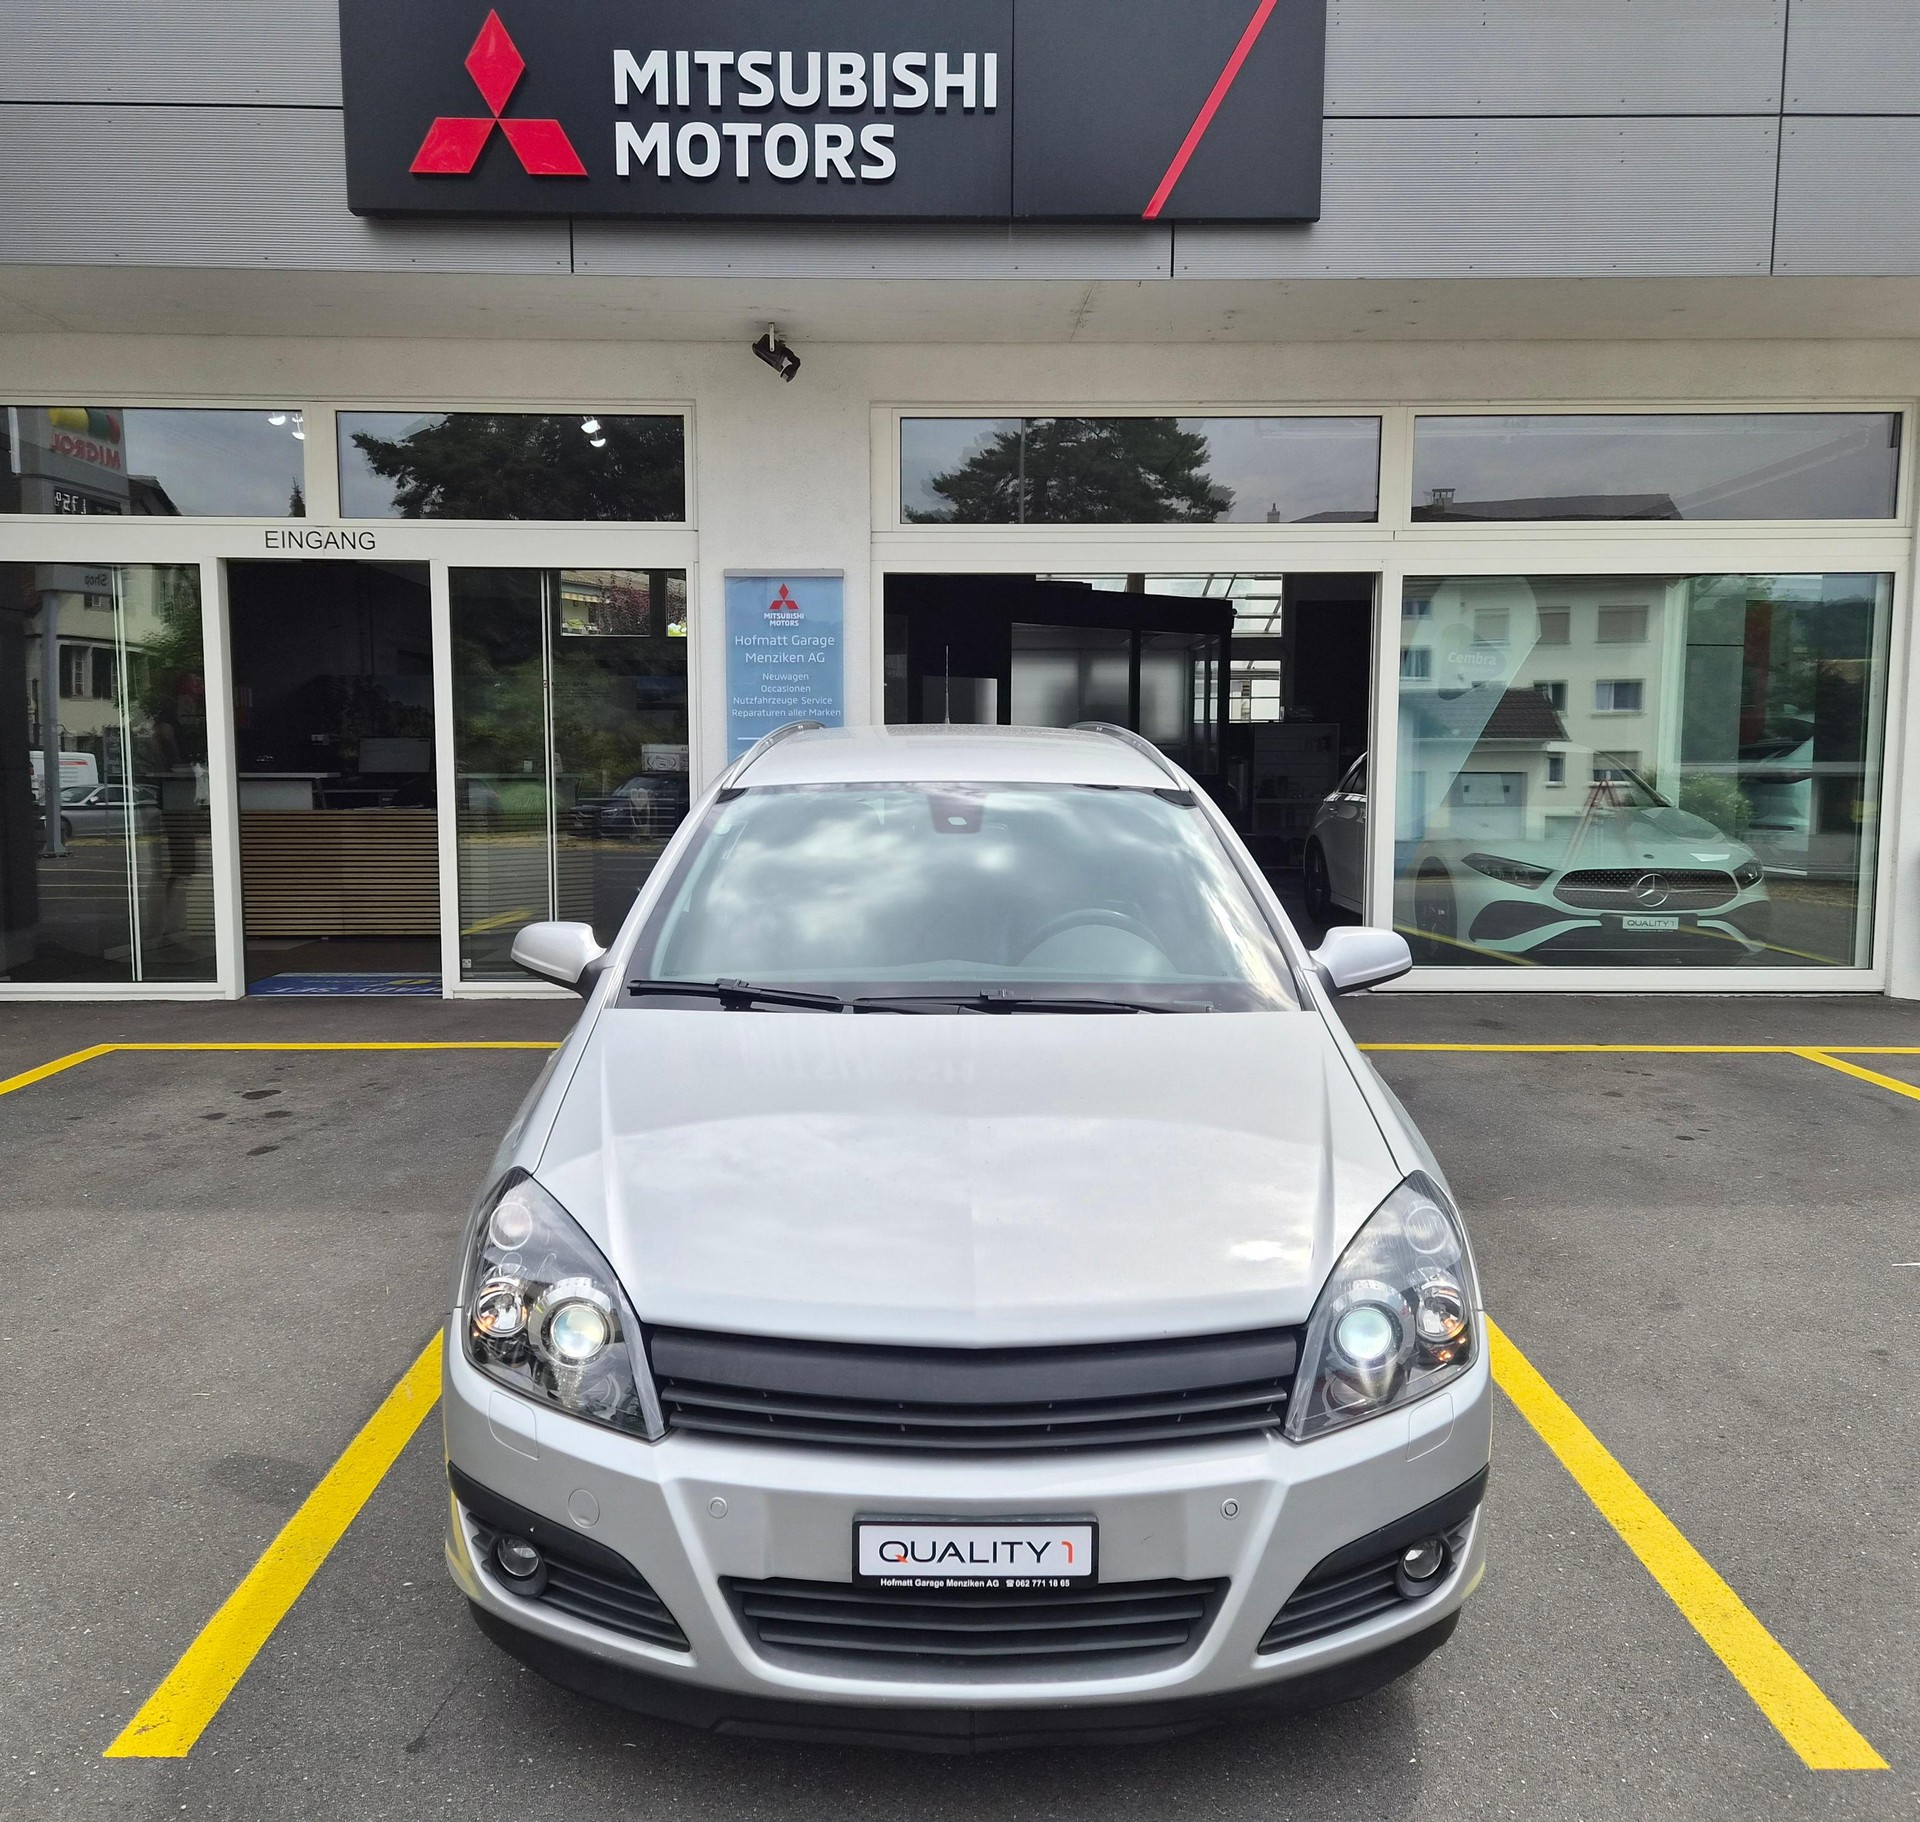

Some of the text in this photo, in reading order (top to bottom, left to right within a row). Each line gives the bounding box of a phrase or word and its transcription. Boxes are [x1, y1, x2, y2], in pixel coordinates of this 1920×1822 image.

[613, 49, 998, 109] MITSUBISHI
[614, 122, 896, 180] MOTORS
[265, 530, 376, 550] EINGANG
[734, 634, 835, 648] Hofmatt Garage
[745, 652, 825, 663] Menziken AG
[1447, 651, 1497, 666] Cembra
[762, 673, 809, 682] Neuwagen
[760, 684, 811, 693] Occasionen
[733, 696, 833, 706] Nutzfahrzeuge Service
[732, 708, 841, 718] Reparaturen aller Marken
[1627, 919, 1669, 927] QUALITY
[878, 1540, 1073, 1564] QUALITY 1
[880, 1578, 913, 1587] Hofmatt
[914, 1578, 944, 1589] Garage
[946, 1579, 985, 1588] Menziken
[986, 1579, 1000, 1588] AG
[1032, 1579, 1046, 1588] 771
[1048, 1579, 1058, 1588] 18
